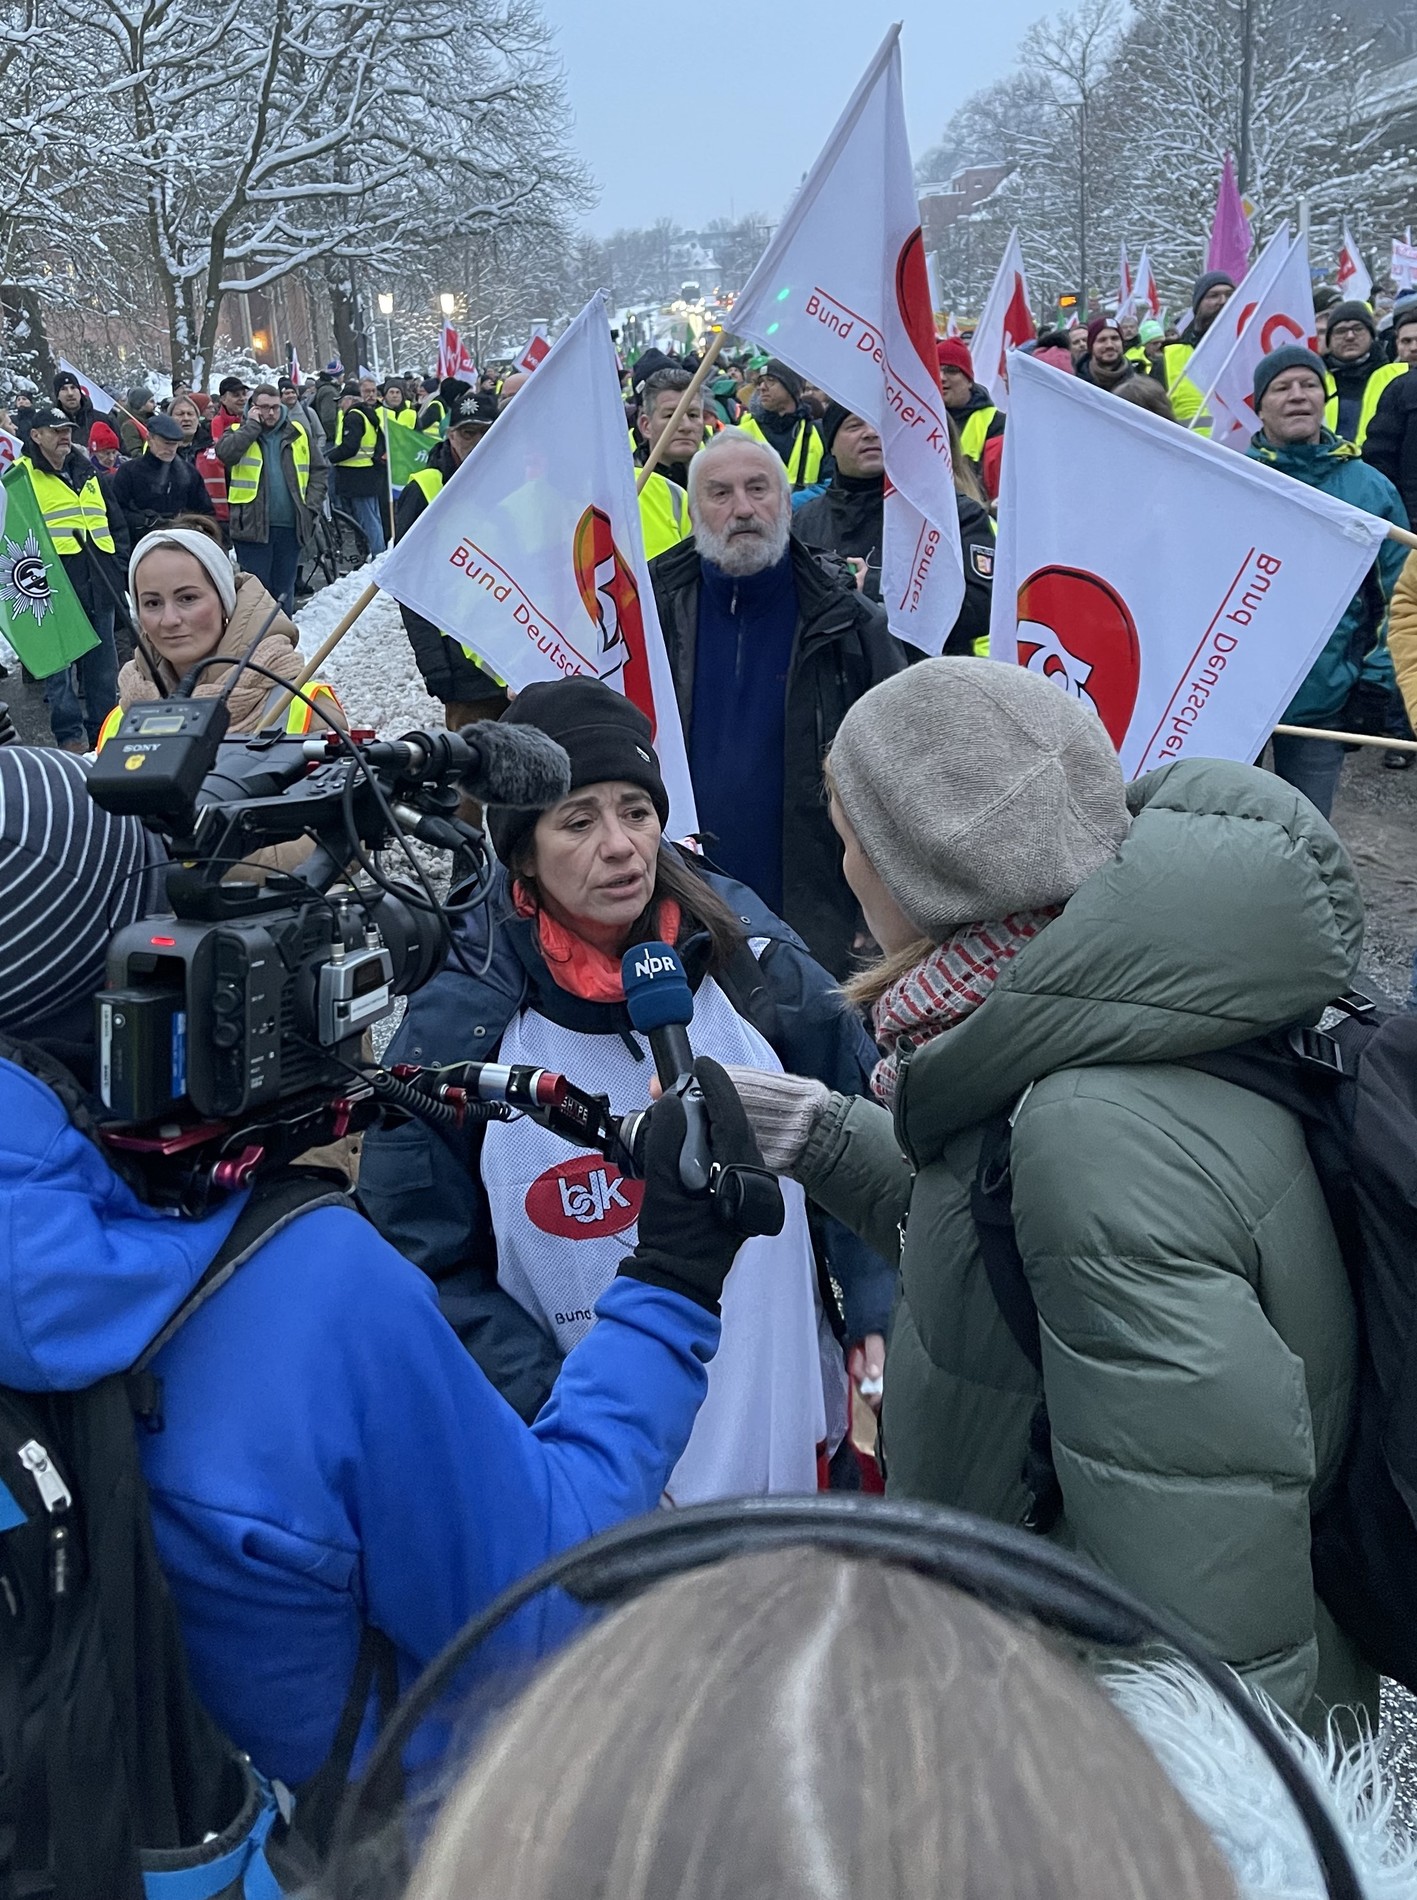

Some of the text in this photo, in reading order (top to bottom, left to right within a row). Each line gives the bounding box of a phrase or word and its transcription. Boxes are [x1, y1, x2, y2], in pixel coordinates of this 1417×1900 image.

[805, 295, 854, 339] Bund
[856, 332, 926, 428] Decher
[449, 545, 512, 603] Bund
[122, 743, 162, 752] SONY
[635, 955, 677, 978] NDR
[561, 1096, 588, 1121] SHPE
[558, 1168, 631, 1223] bdk
